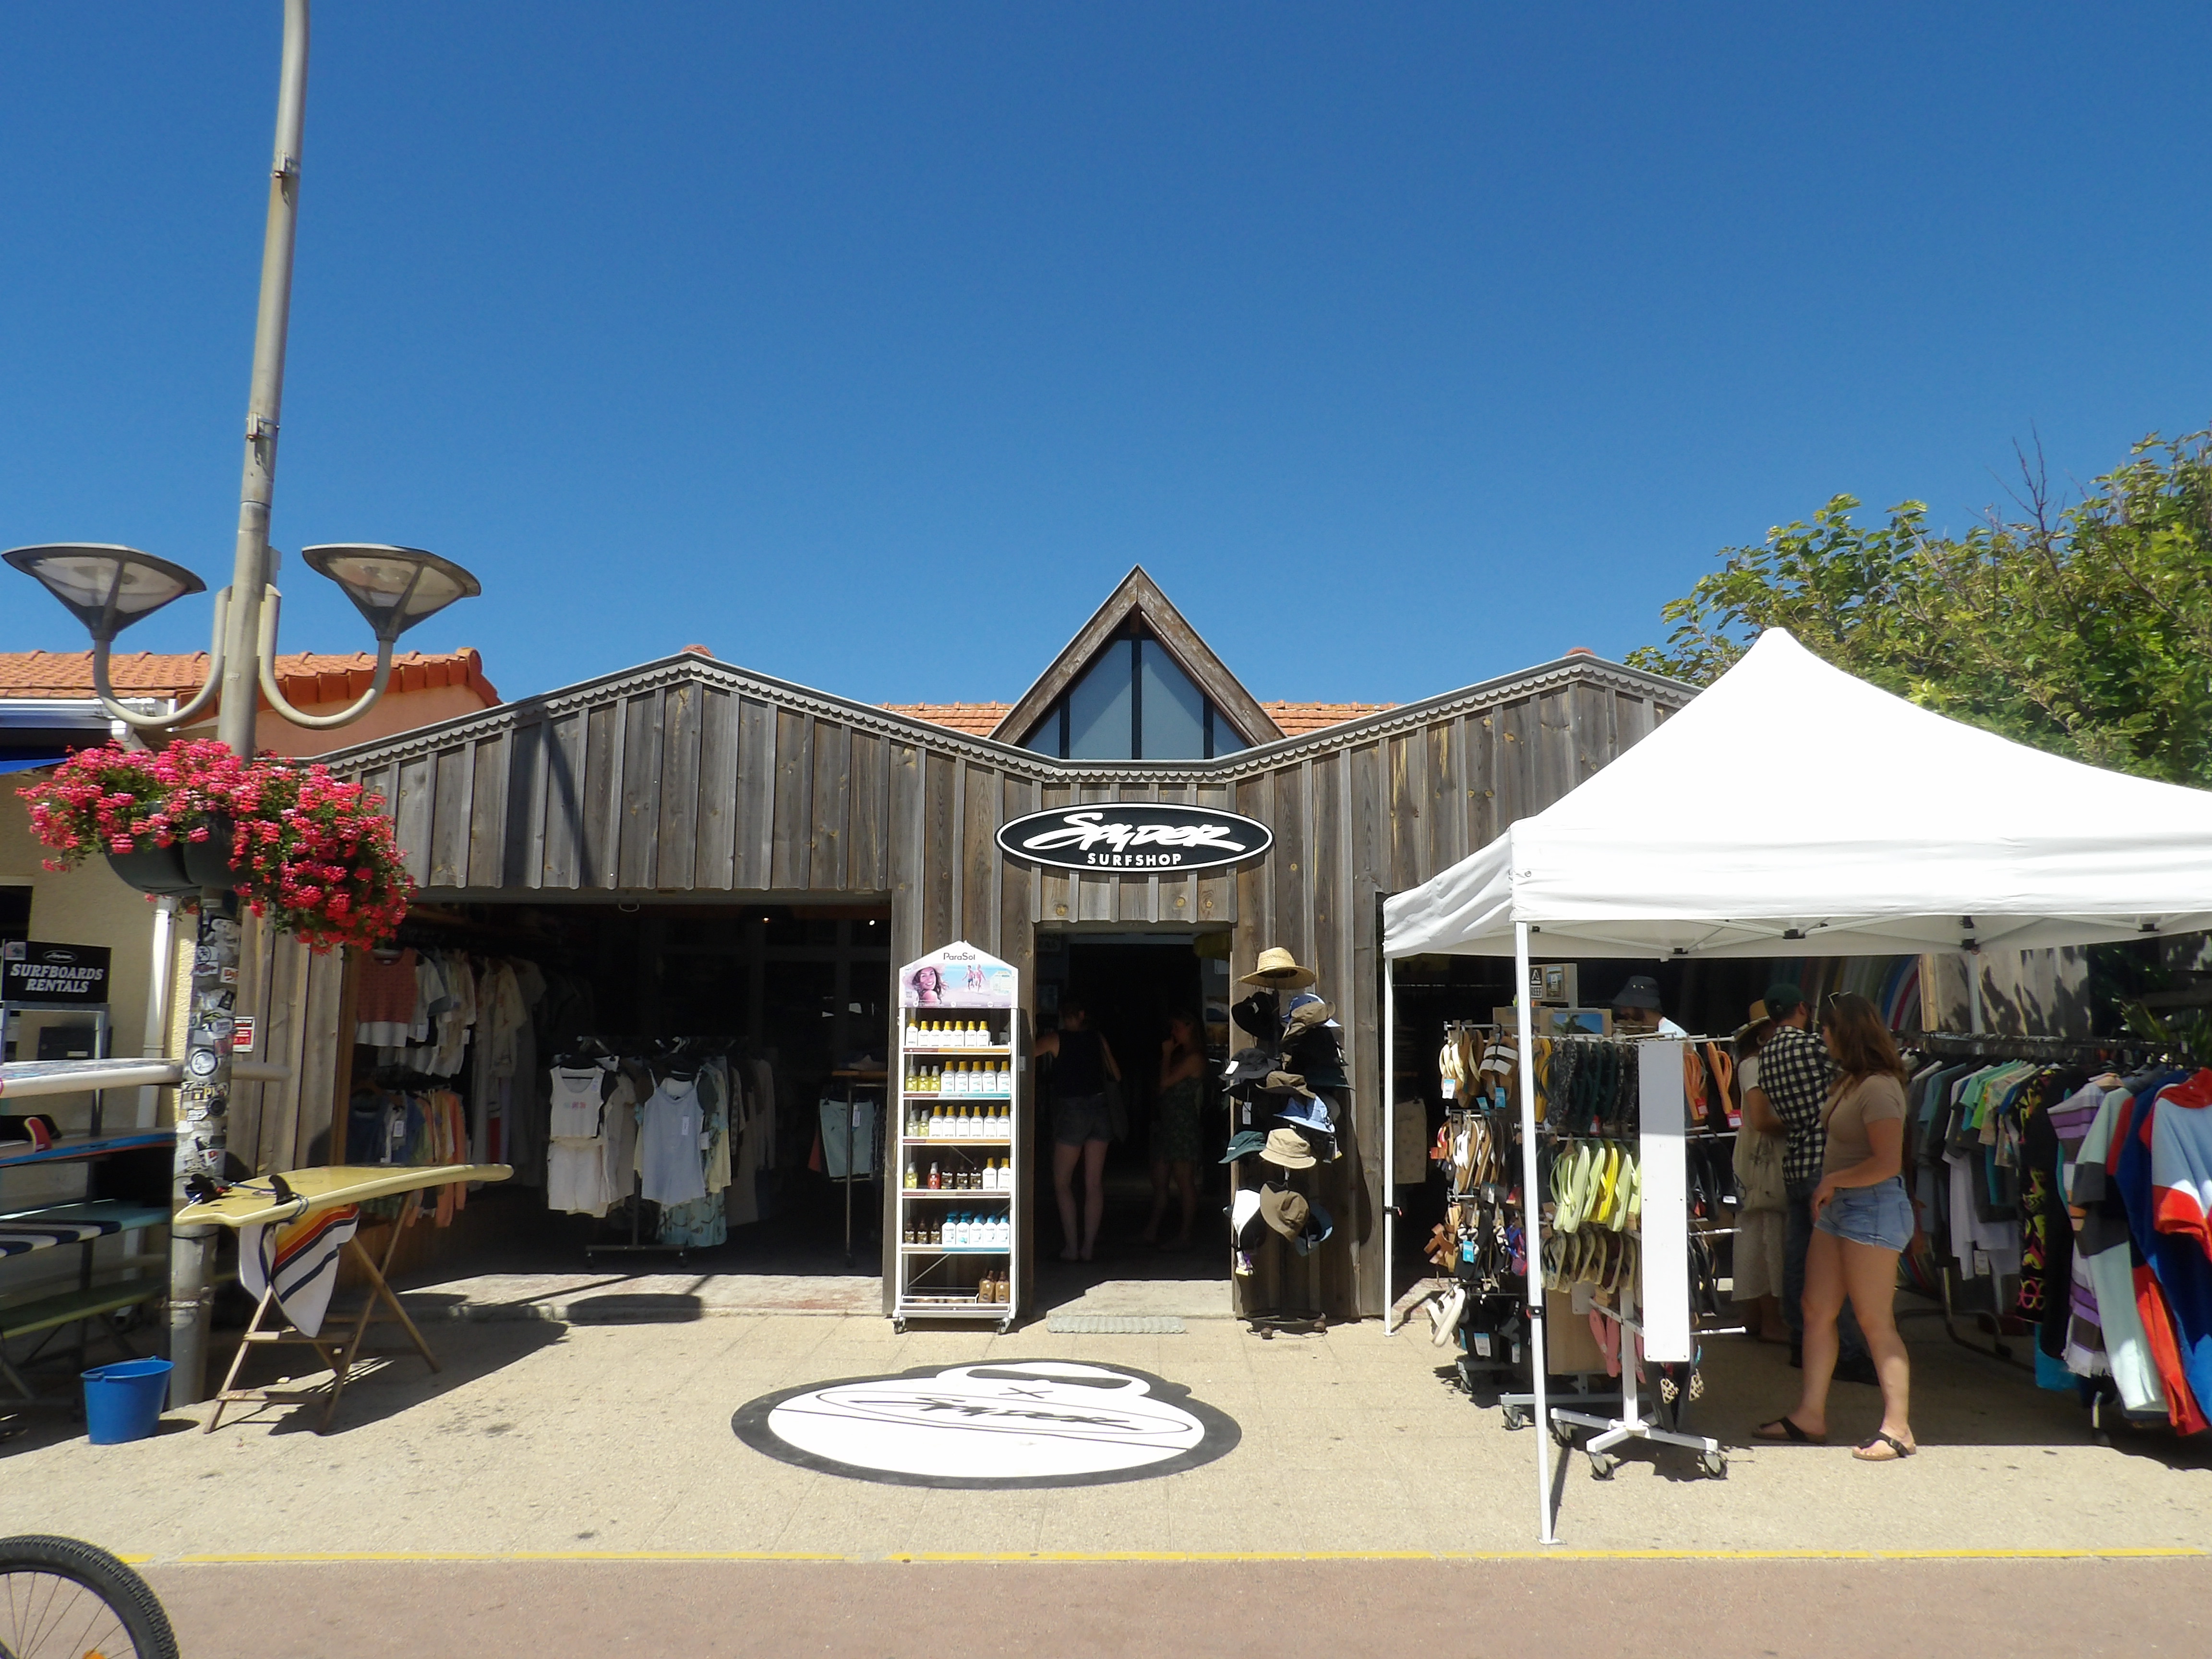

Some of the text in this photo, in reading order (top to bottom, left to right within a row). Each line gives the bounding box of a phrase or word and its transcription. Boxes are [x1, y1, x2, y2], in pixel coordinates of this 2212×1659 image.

[1087, 853, 1182, 866] SURFSHOP
[943, 952, 975, 961] ParaSol
[10, 963, 104, 980] SURFBOARDS
[25, 978, 90, 993] RENTALS
